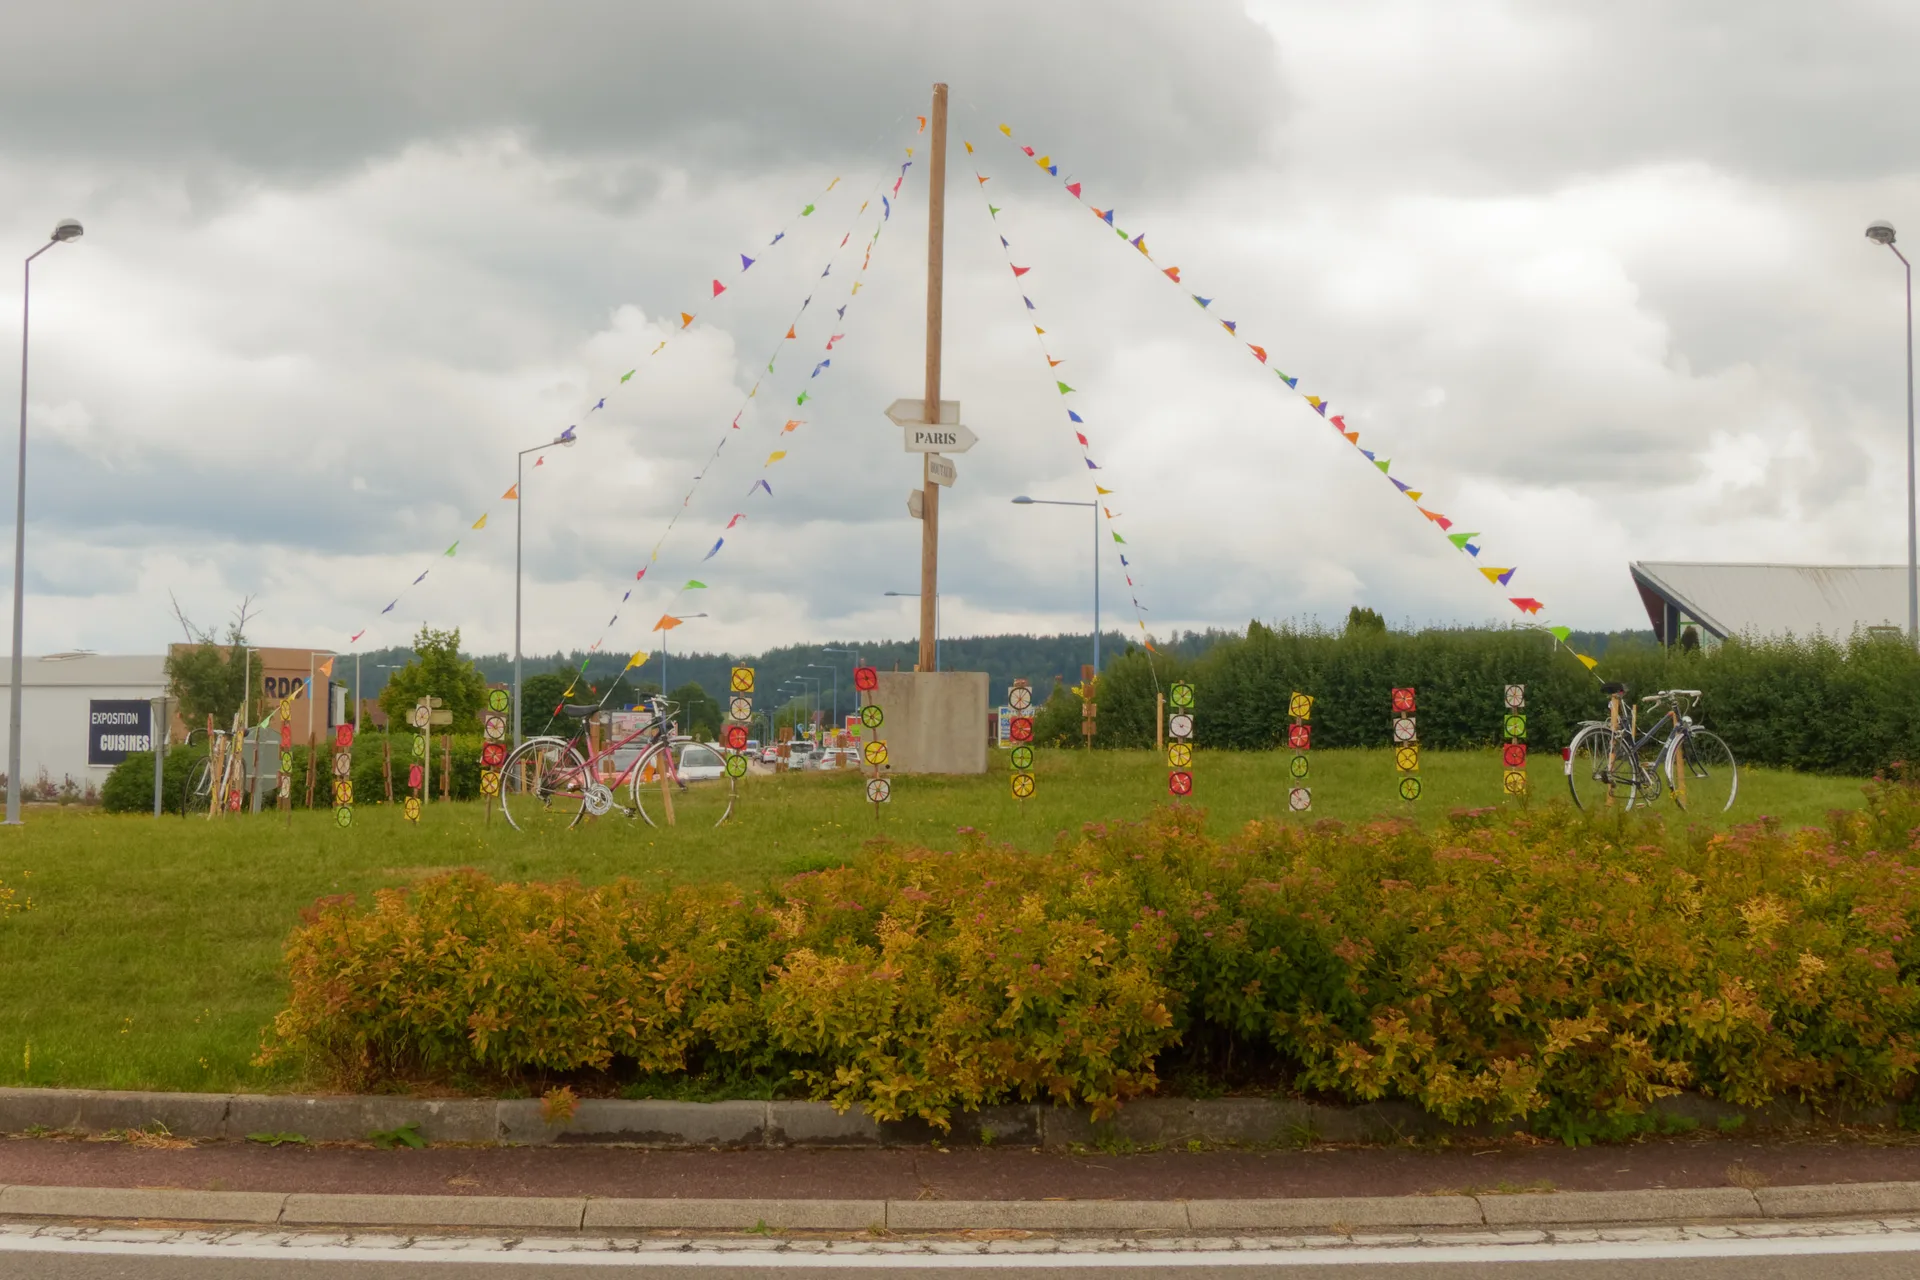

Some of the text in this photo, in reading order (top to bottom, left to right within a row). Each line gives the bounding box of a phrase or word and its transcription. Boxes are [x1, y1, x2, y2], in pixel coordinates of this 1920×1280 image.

[915, 432, 957, 445] PARIS
[91, 712, 139, 725] EXPOSITION
[100, 734, 150, 751] CUISINES
